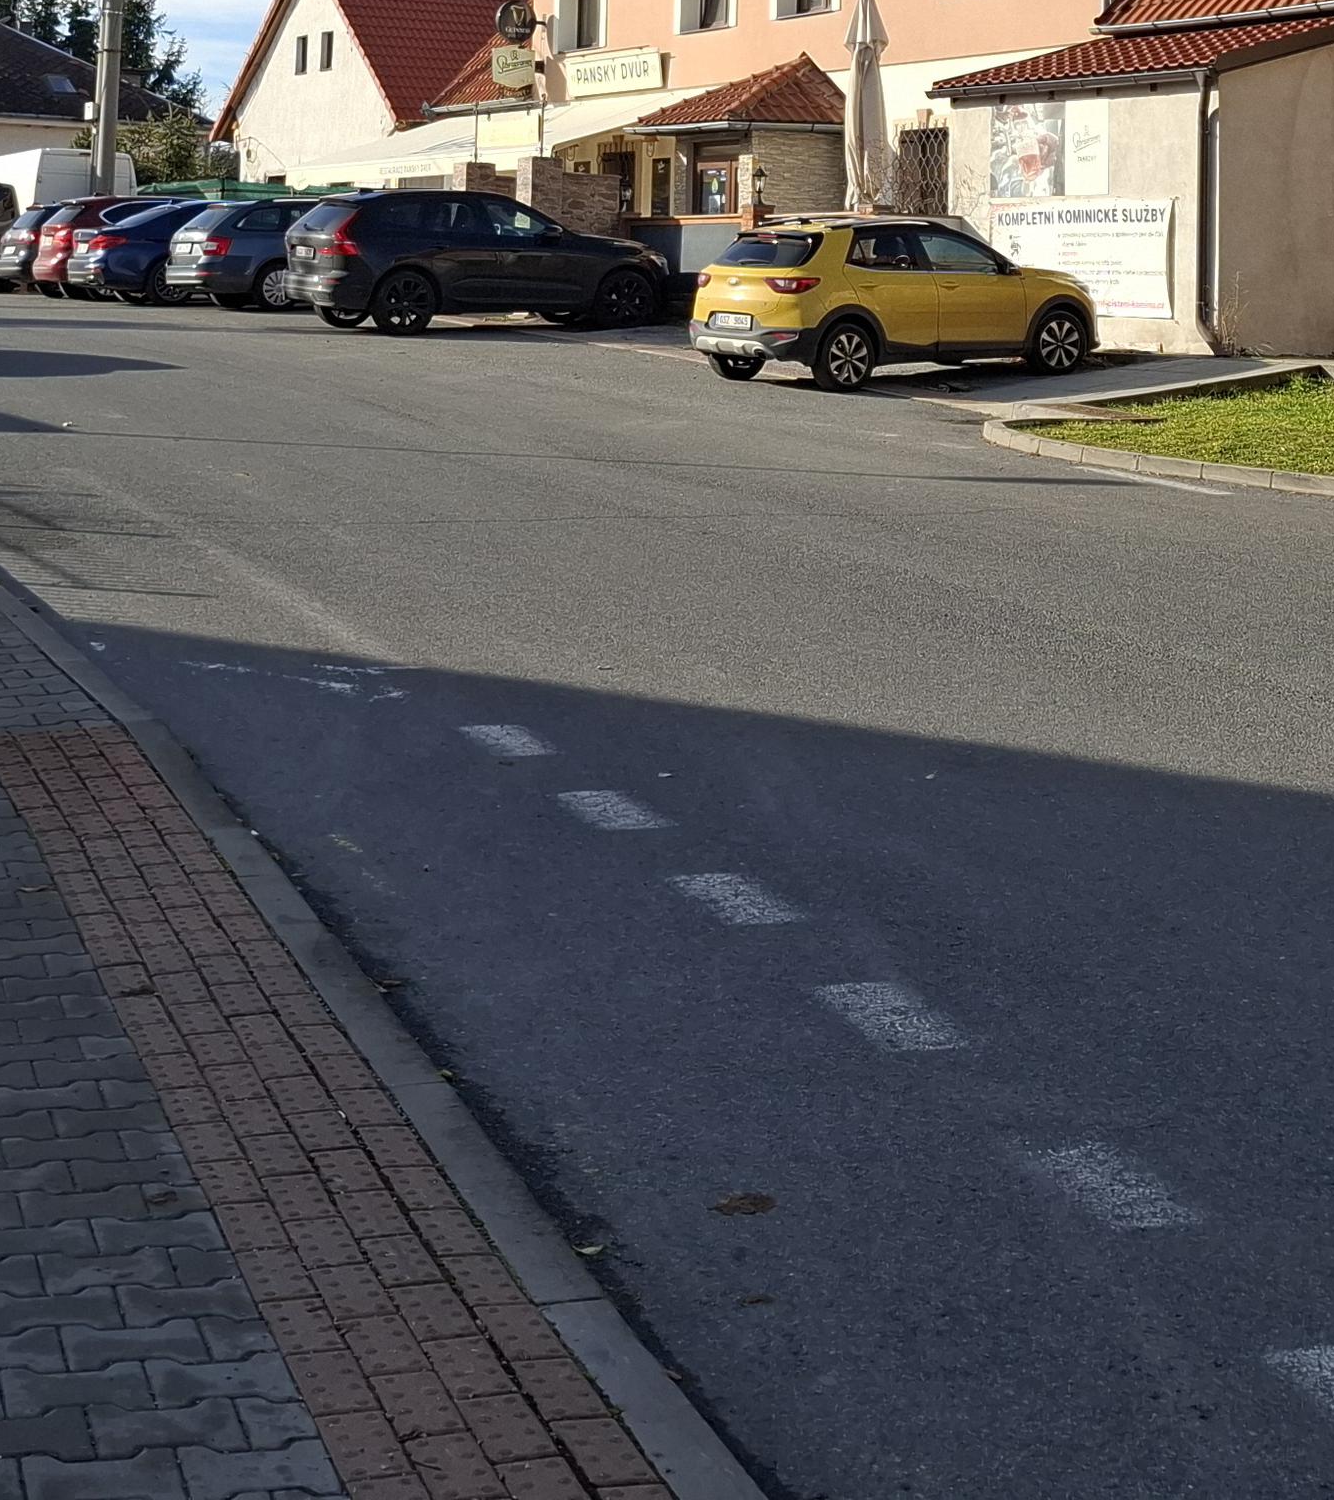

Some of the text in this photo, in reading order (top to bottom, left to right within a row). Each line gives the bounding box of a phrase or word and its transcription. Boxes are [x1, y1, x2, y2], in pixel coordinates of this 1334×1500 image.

[997, 204, 1166, 227] KOMPLETNÍ KOMINICKÉ SLUŽBY
